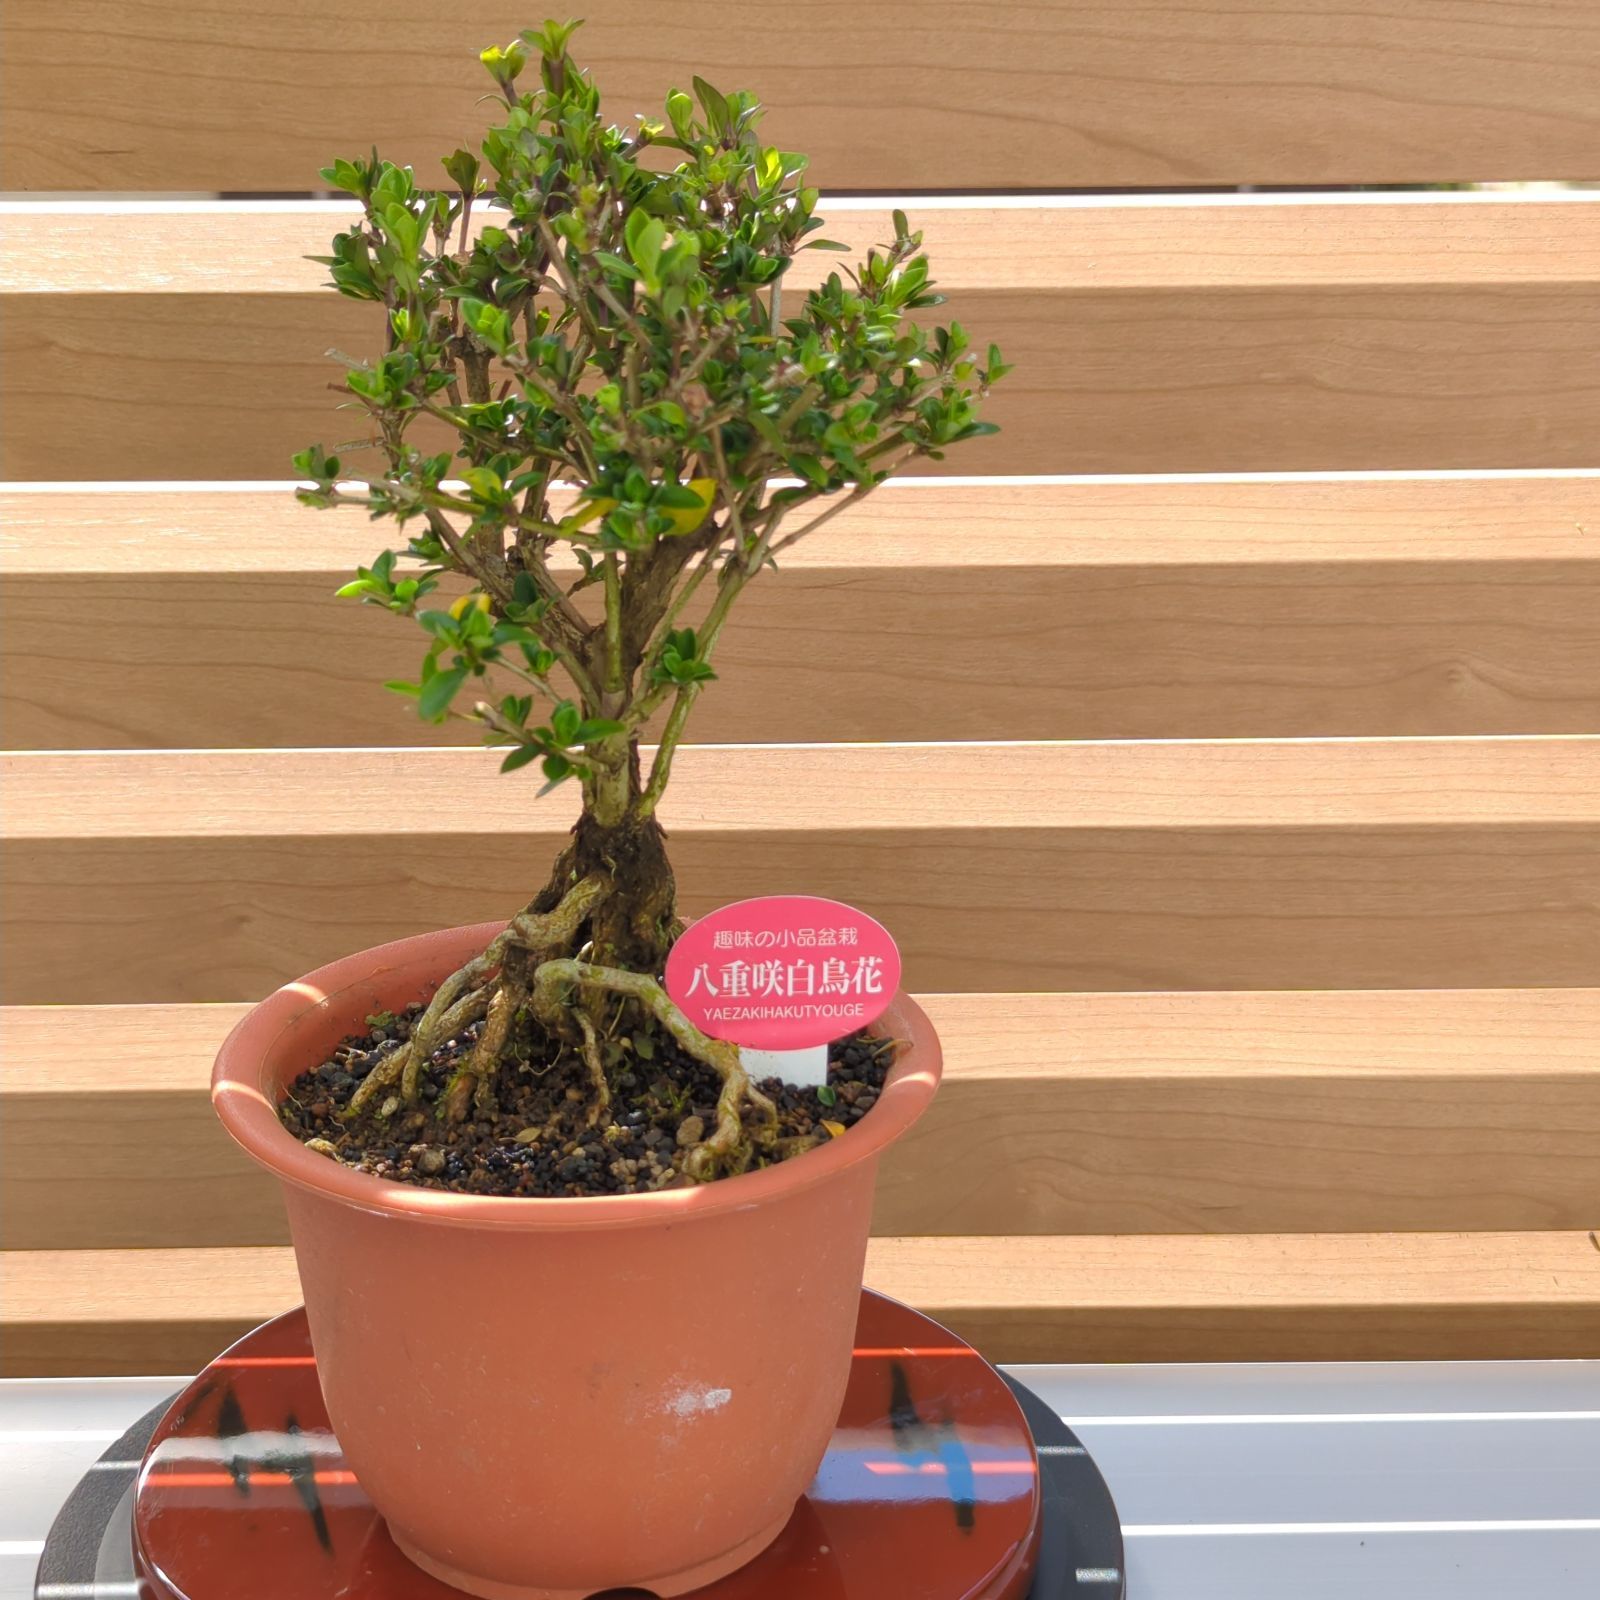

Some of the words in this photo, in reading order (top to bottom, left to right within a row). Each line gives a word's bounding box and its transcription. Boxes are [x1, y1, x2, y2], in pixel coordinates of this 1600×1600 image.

[713, 927, 858, 950] 趣味の小品盆栽
[684, 956, 884, 998] 八重咲白鳥花
[703, 1003, 864, 1021] YAEZAKIHAKUTYOUGE
